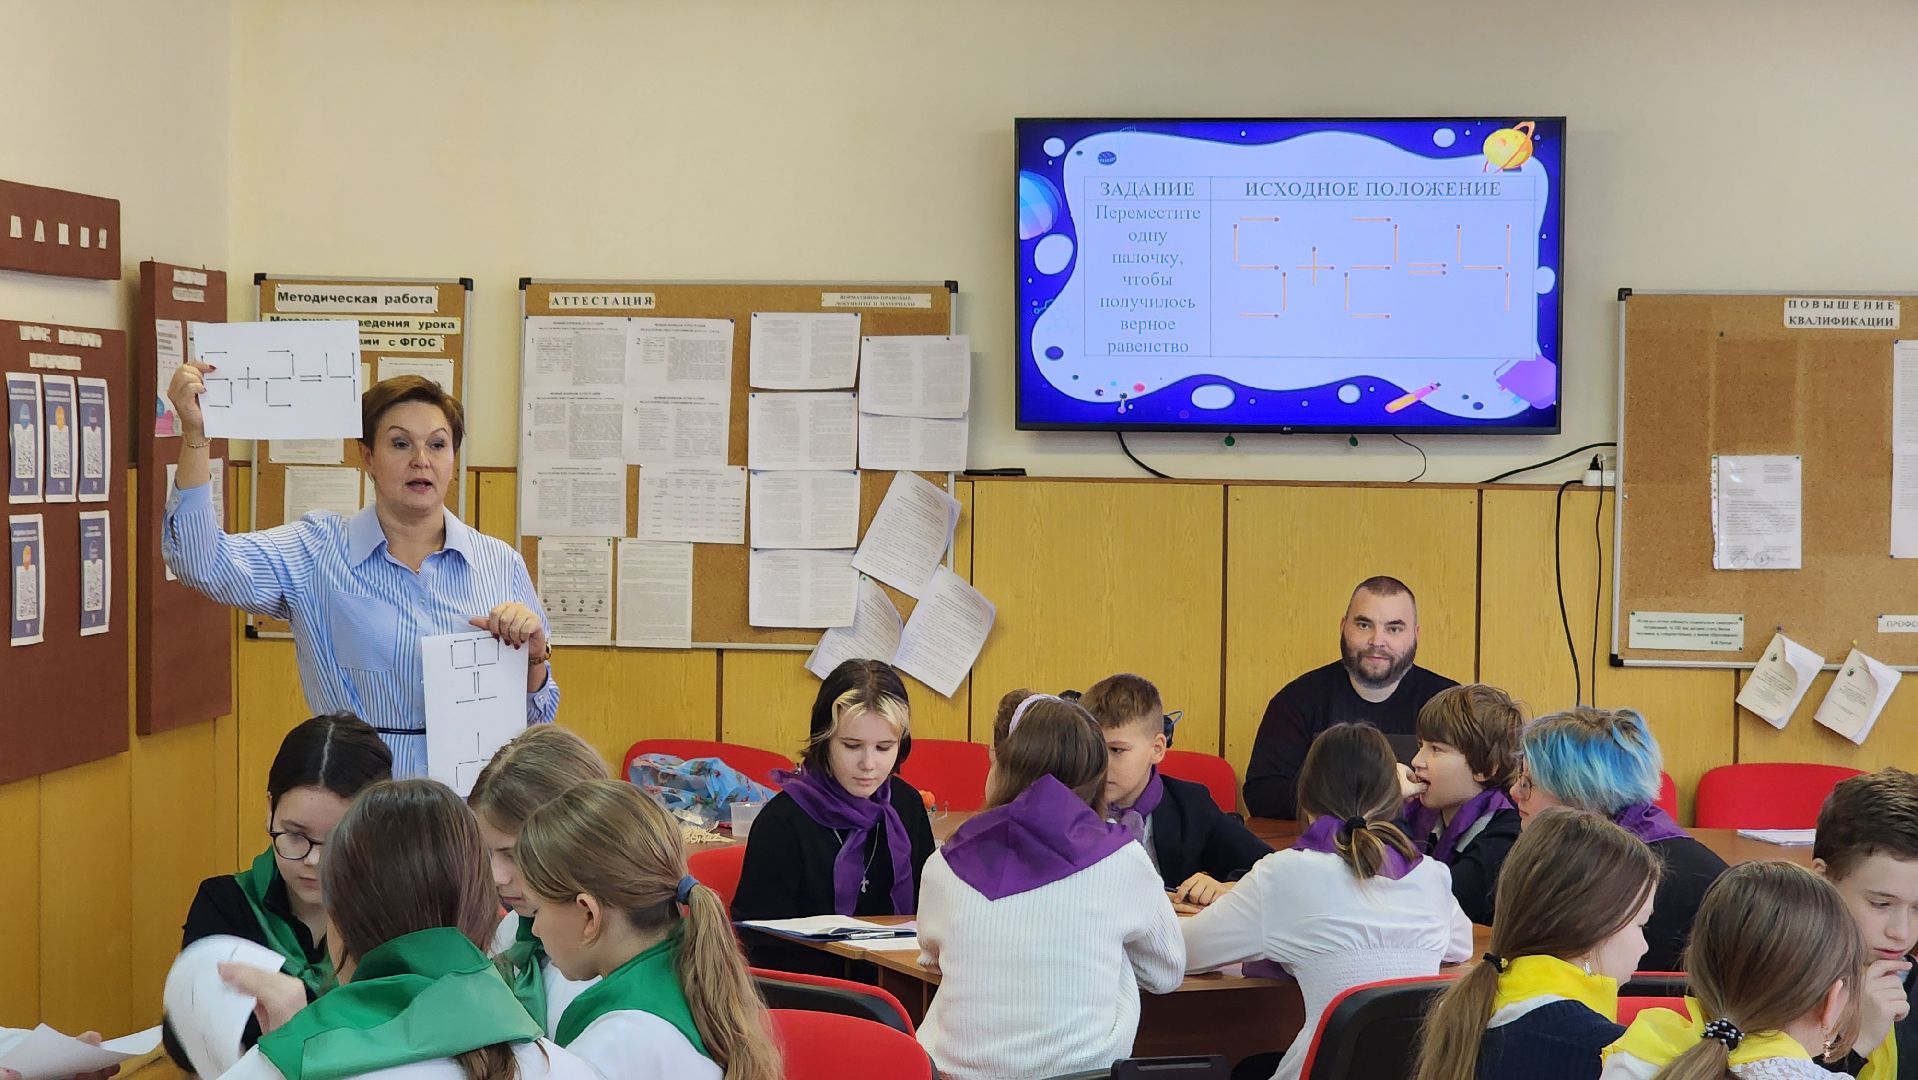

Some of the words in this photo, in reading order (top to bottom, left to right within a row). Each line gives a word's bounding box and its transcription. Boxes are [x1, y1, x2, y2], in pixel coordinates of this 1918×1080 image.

[1100, 181, 1195, 199] ЗАДАНИЕ
[1245, 182, 1359, 198] ИСХОДНОЕ
[1365, 181, 1501, 197] ПОЛОЖЕНИЕ
[1095, 205, 1201, 223] Переместите
[1128, 231, 1168, 246] одну
[1112, 252, 1184, 268] палочку,
[1123, 272, 1173, 286] чтобы
[277, 291, 378, 304] Методическая
[384, 293, 433, 305] работа
[551, 296, 653, 306] АТТЕСТАЦИЯ
[1100, 297, 1196, 312] получилось
[1788, 300, 1895, 310] ПОВЫШЕНИЕ
[418, 321, 456, 331] урока
[1120, 320, 1176, 334] верное
[1788, 316, 1894, 328] КВАЛИФИКАЦИИ
[388, 339, 396, 347] с
[400, 338, 437, 348] ФГОС
[1108, 342, 1189, 356] равенство
[1886, 620, 1918, 628] ПРОФС
